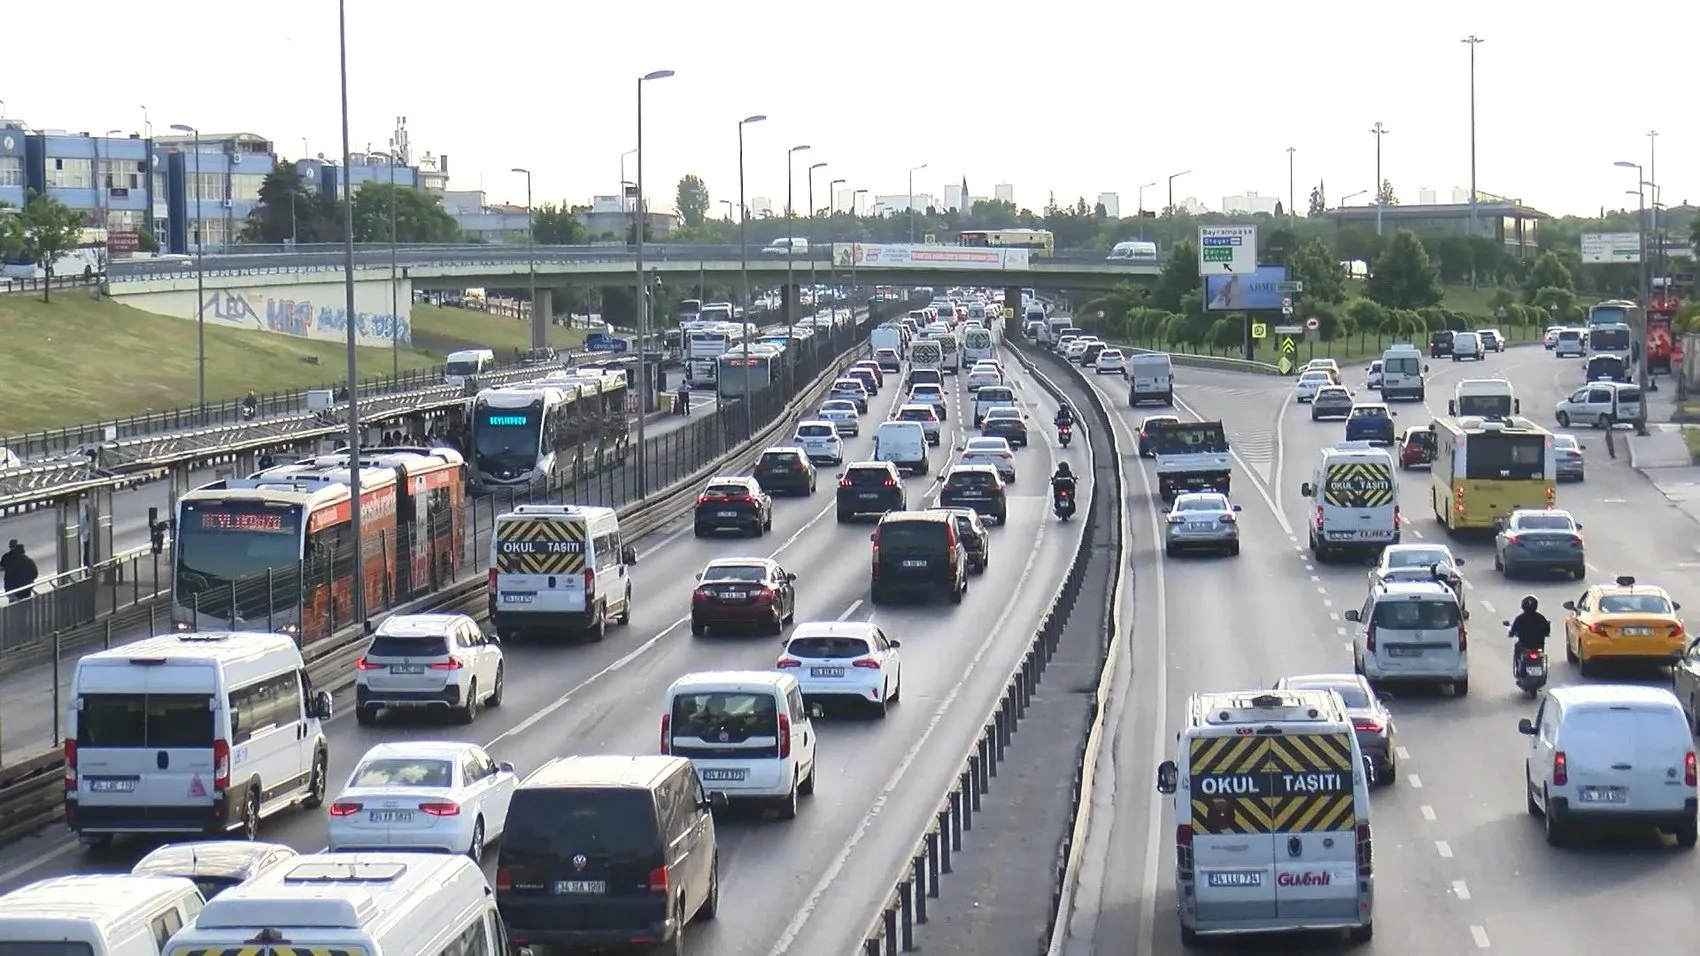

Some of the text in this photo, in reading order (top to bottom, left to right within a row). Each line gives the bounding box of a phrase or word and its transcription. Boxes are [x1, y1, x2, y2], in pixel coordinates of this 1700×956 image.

[1330, 482, 1352, 490] OKUL
[503, 542, 535, 552] OKUL
[1201, 774, 1341, 794] OKUL TAŞITI
